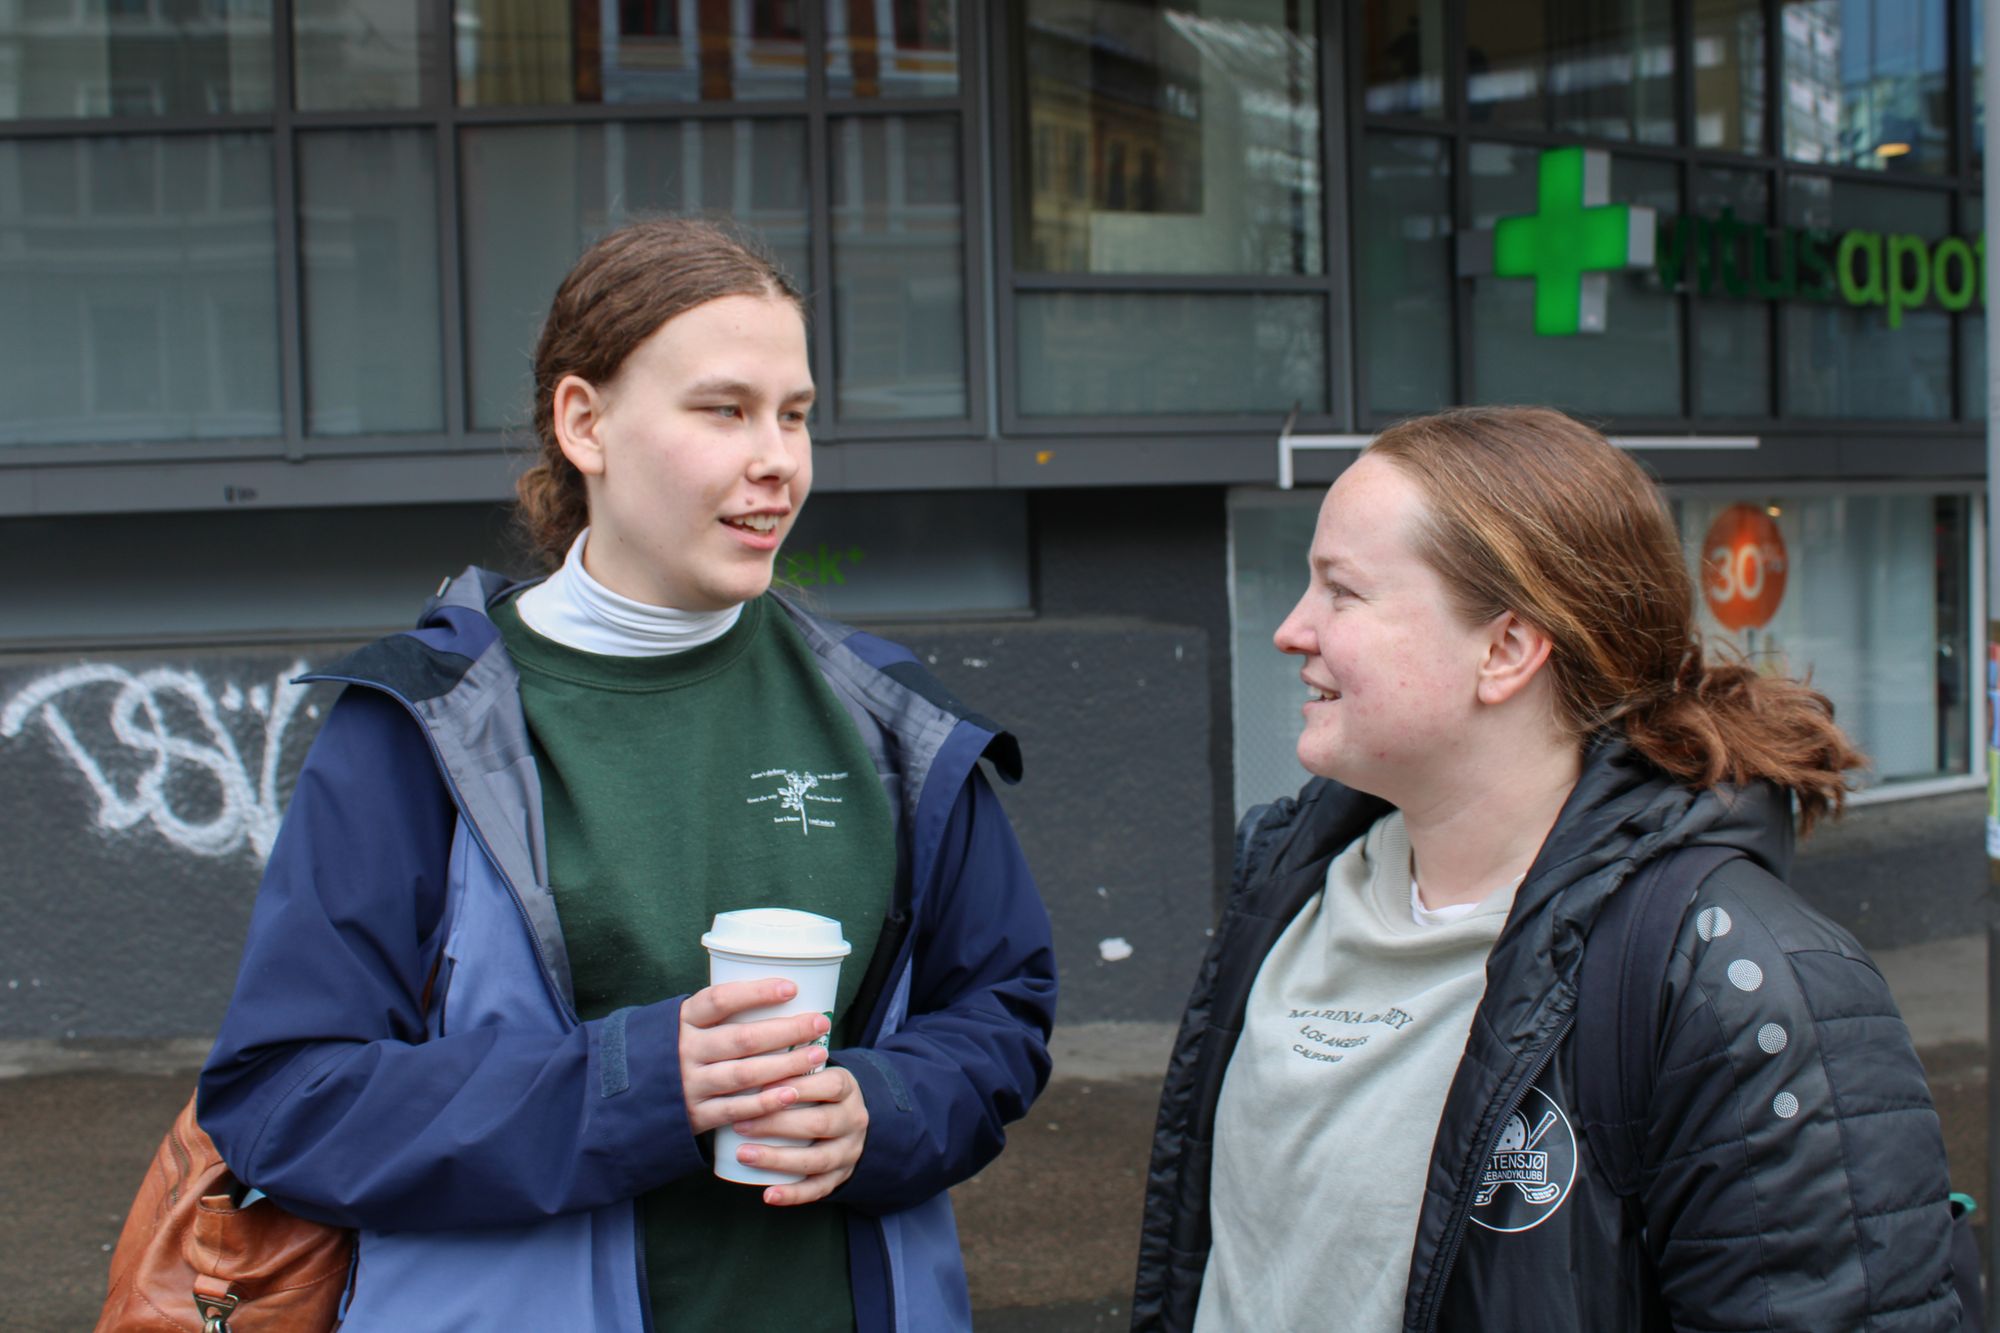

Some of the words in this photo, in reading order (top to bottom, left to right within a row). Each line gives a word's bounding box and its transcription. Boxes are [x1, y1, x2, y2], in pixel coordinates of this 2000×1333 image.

[1288, 1009, 1363, 1024] MARINA
[1299, 1025, 1327, 1042] LOS
[1487, 1154, 1545, 1170] TENSJØ
[1484, 1170, 1543, 1181] EBANDYKLUBB
